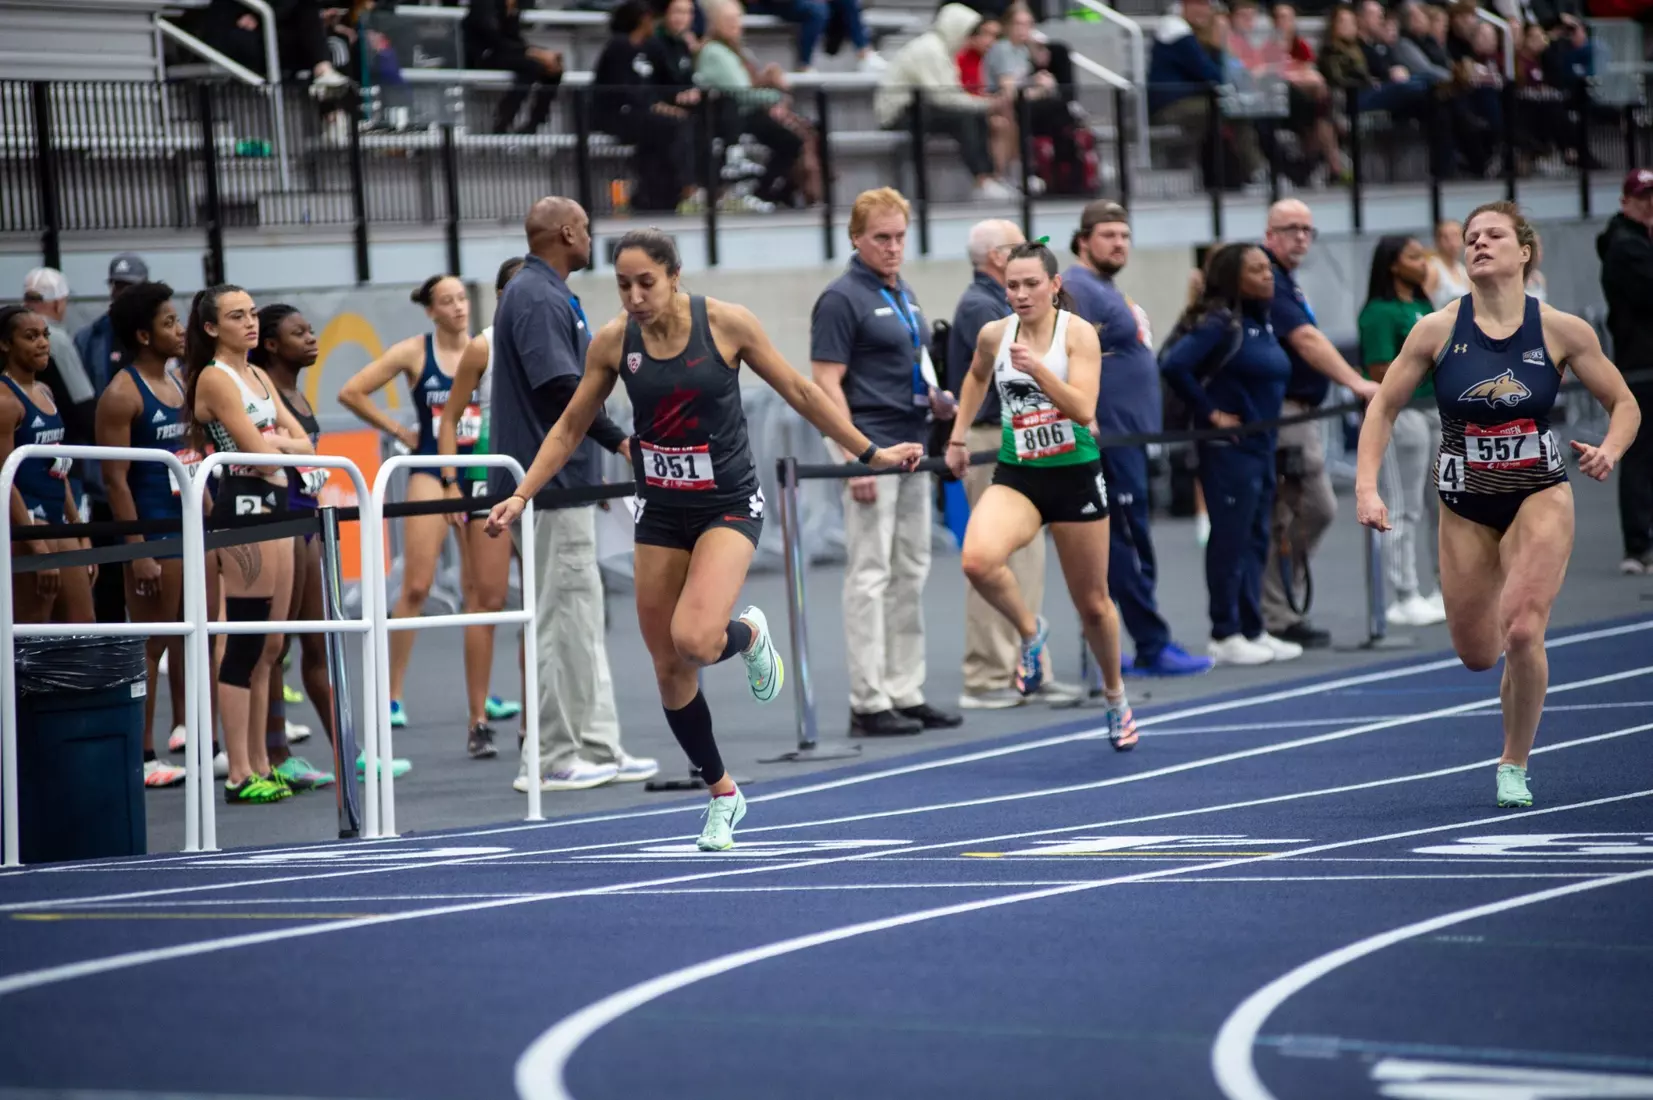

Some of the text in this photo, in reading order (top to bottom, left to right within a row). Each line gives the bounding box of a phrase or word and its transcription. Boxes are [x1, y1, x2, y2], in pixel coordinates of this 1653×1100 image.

[1024, 423, 1065, 450] 806
[1477, 435, 1526, 461] 557
[1548, 430, 1560, 465] 4
[653, 452, 700, 479] 851
[1443, 457, 1459, 490] 4
